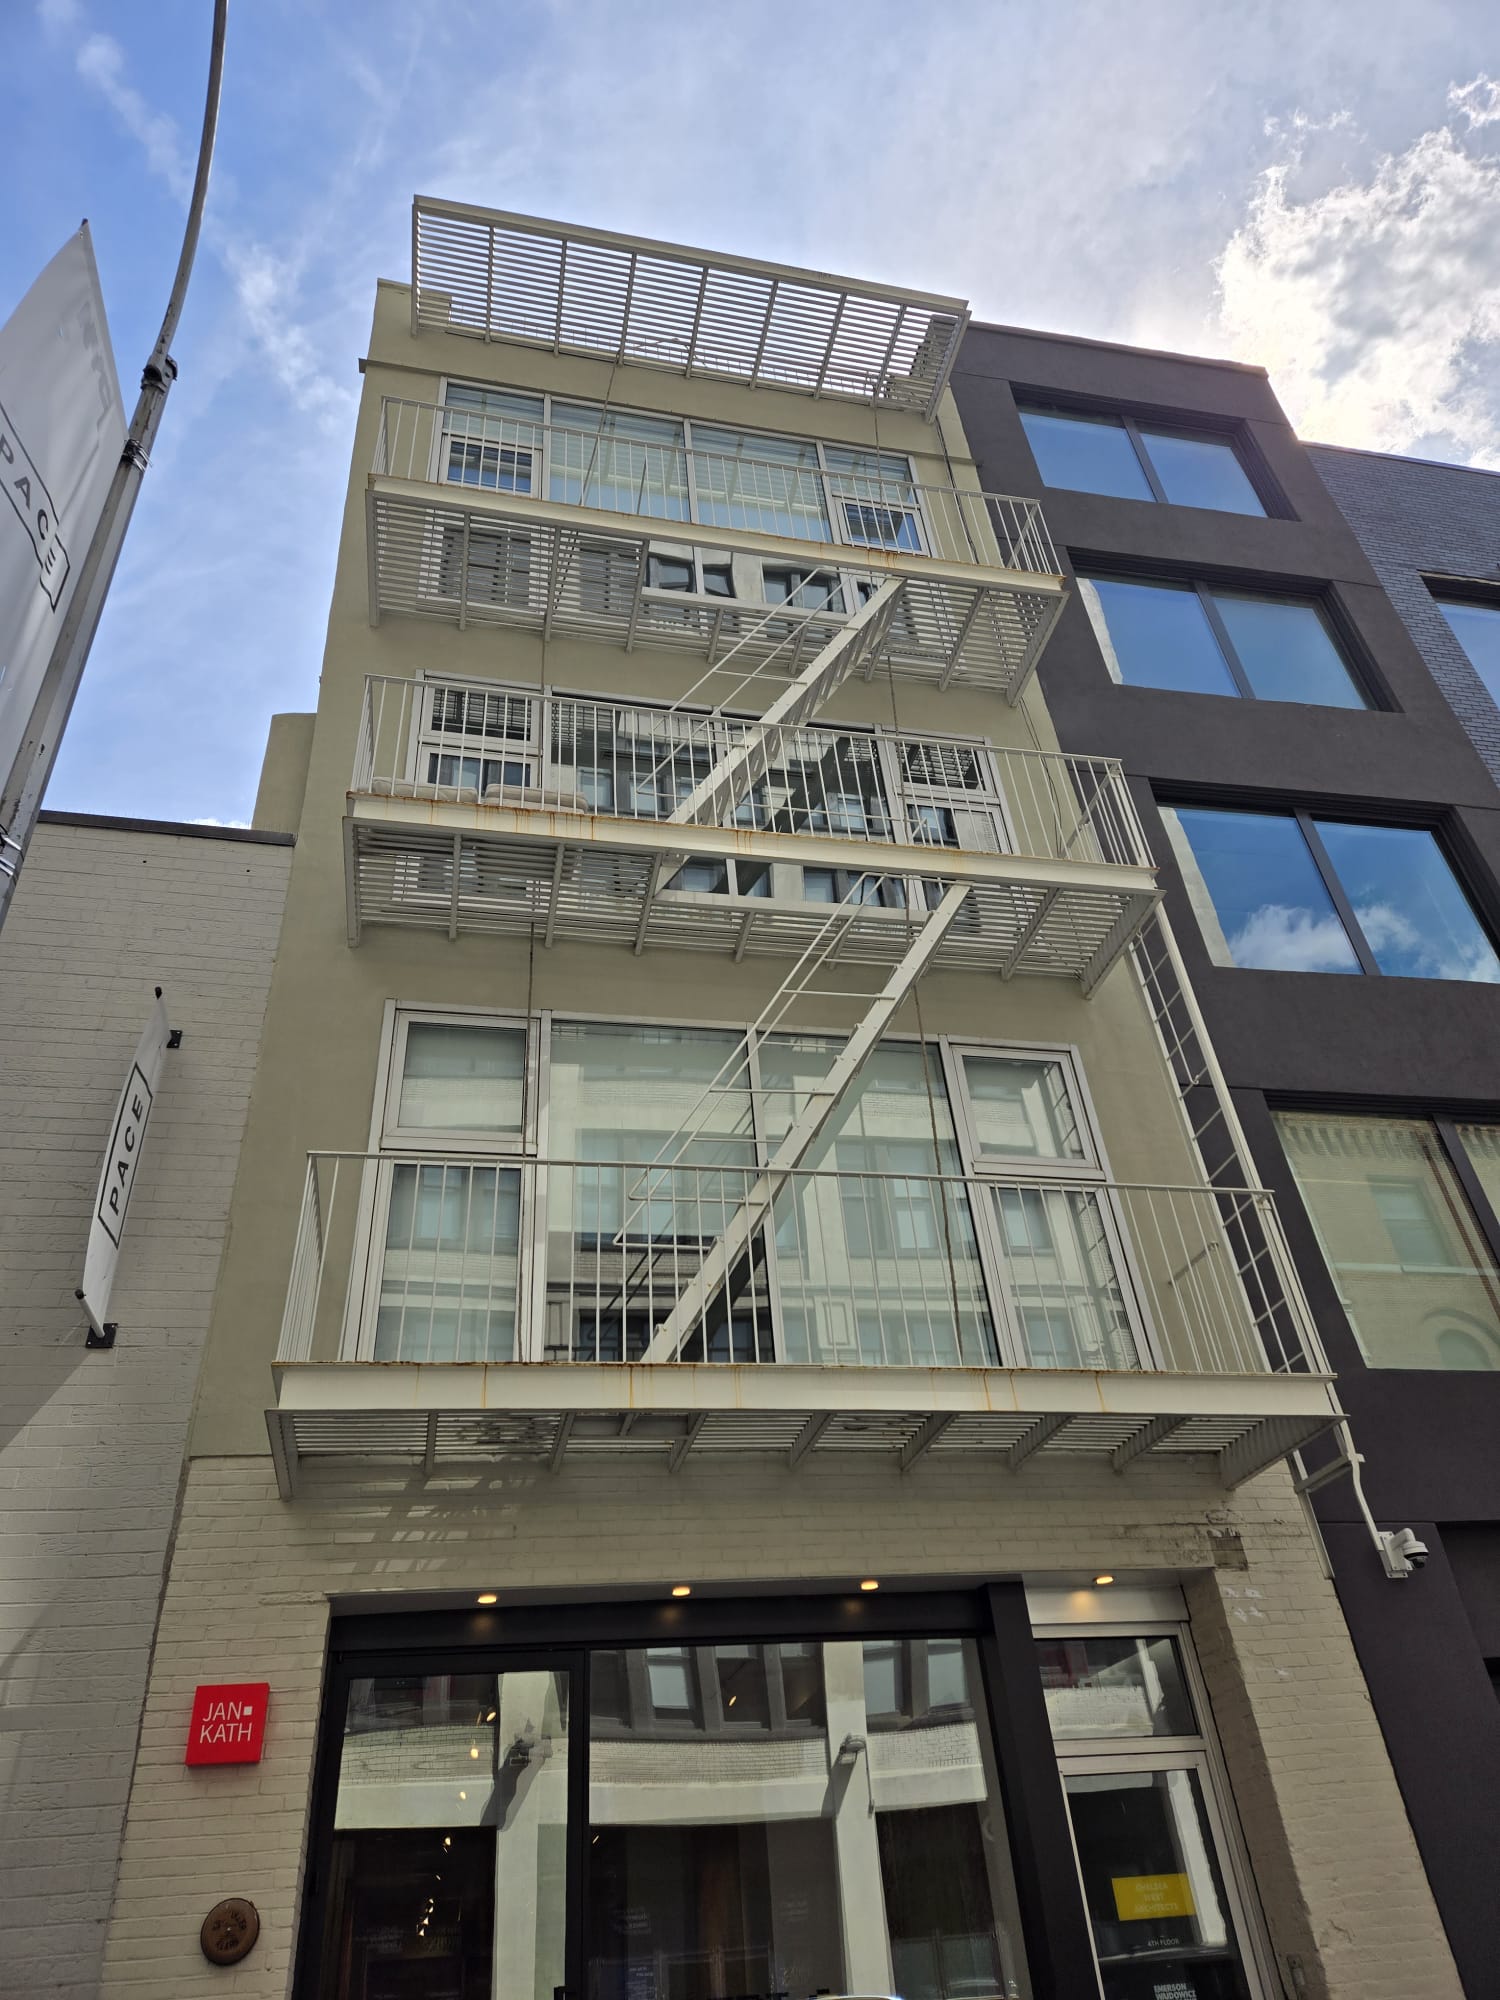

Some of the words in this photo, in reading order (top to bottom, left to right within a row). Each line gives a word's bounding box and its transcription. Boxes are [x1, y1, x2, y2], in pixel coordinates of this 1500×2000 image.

[0, 433, 56, 575] PACE
[109, 1094, 143, 1216] PACE
[202, 1701, 242, 1722] JAN
[199, 1722, 252, 1744] KATH
[1160, 1938, 1180, 1946] FLOOR
[1153, 1982, 1187, 1993] EMERSON
